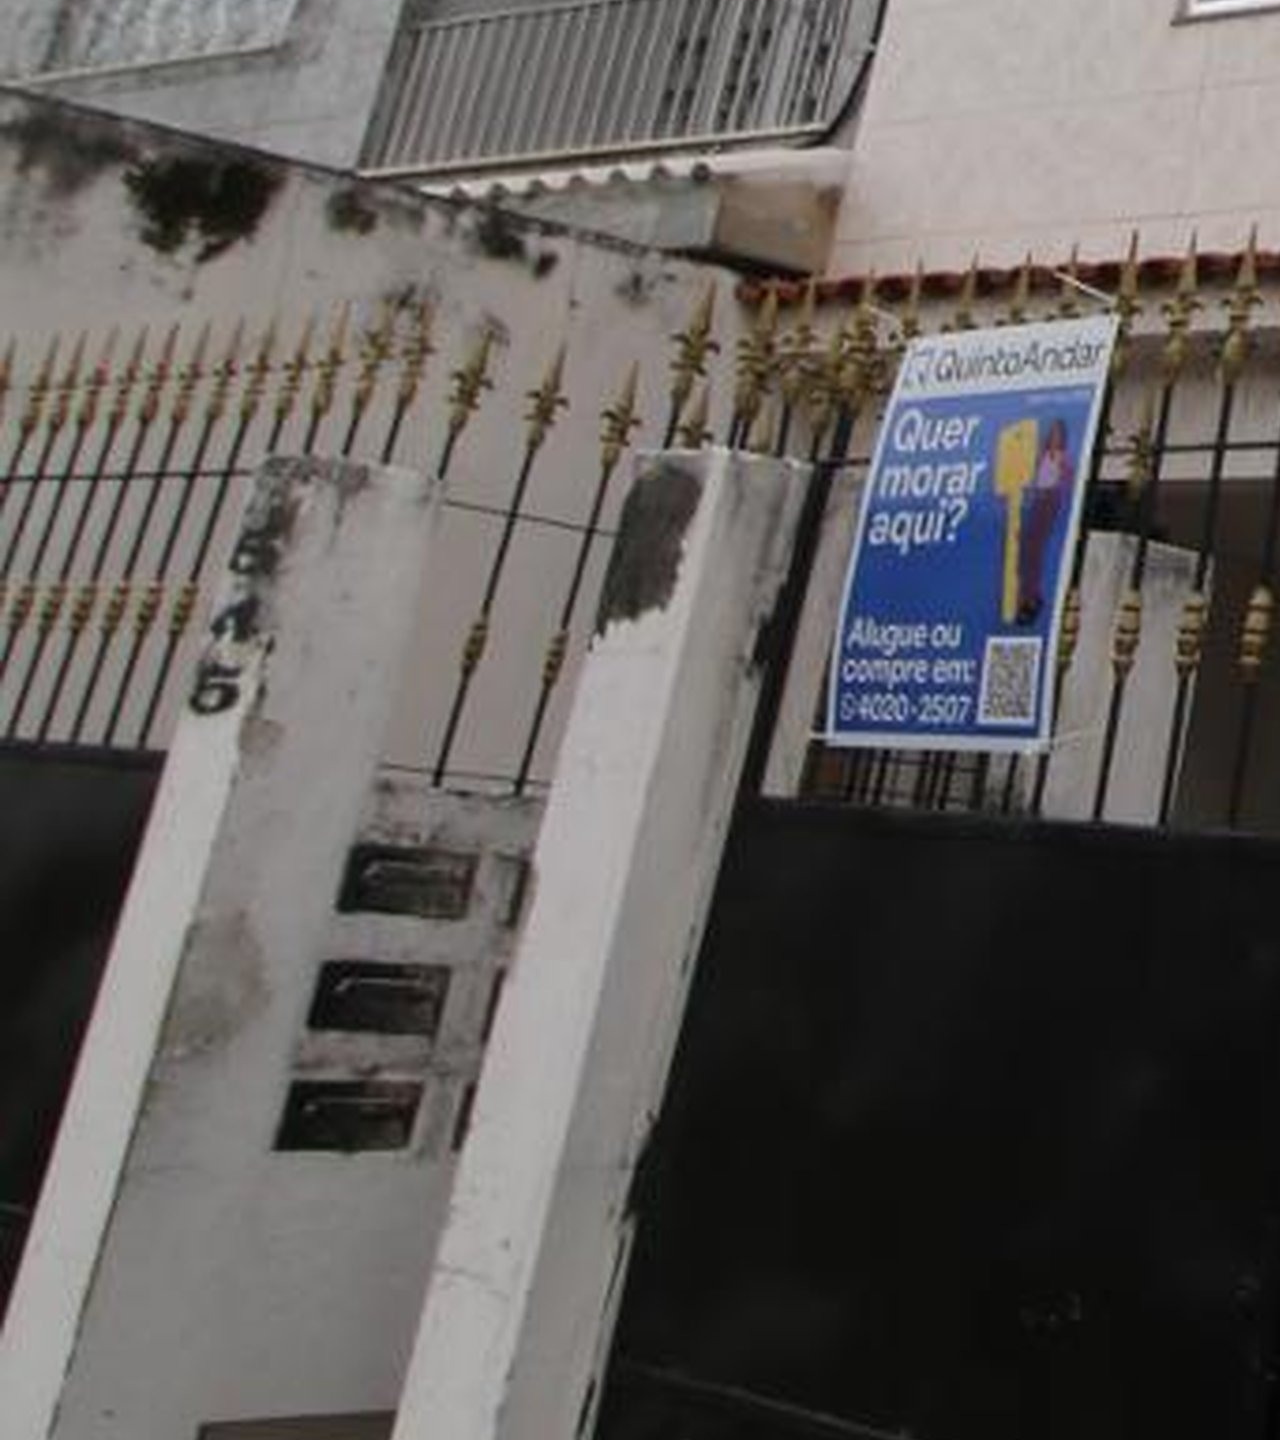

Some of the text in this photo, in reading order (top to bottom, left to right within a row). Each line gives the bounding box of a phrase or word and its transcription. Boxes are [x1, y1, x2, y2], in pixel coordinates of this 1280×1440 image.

[935, 338, 1104, 383] QuintoAndar
[894, 408, 981, 452] Quer
[880, 462, 986, 498] morar
[868, 498, 968, 554] aqui?
[847, 618, 961, 656] Alugue ou
[842, 659, 926, 689] compre
